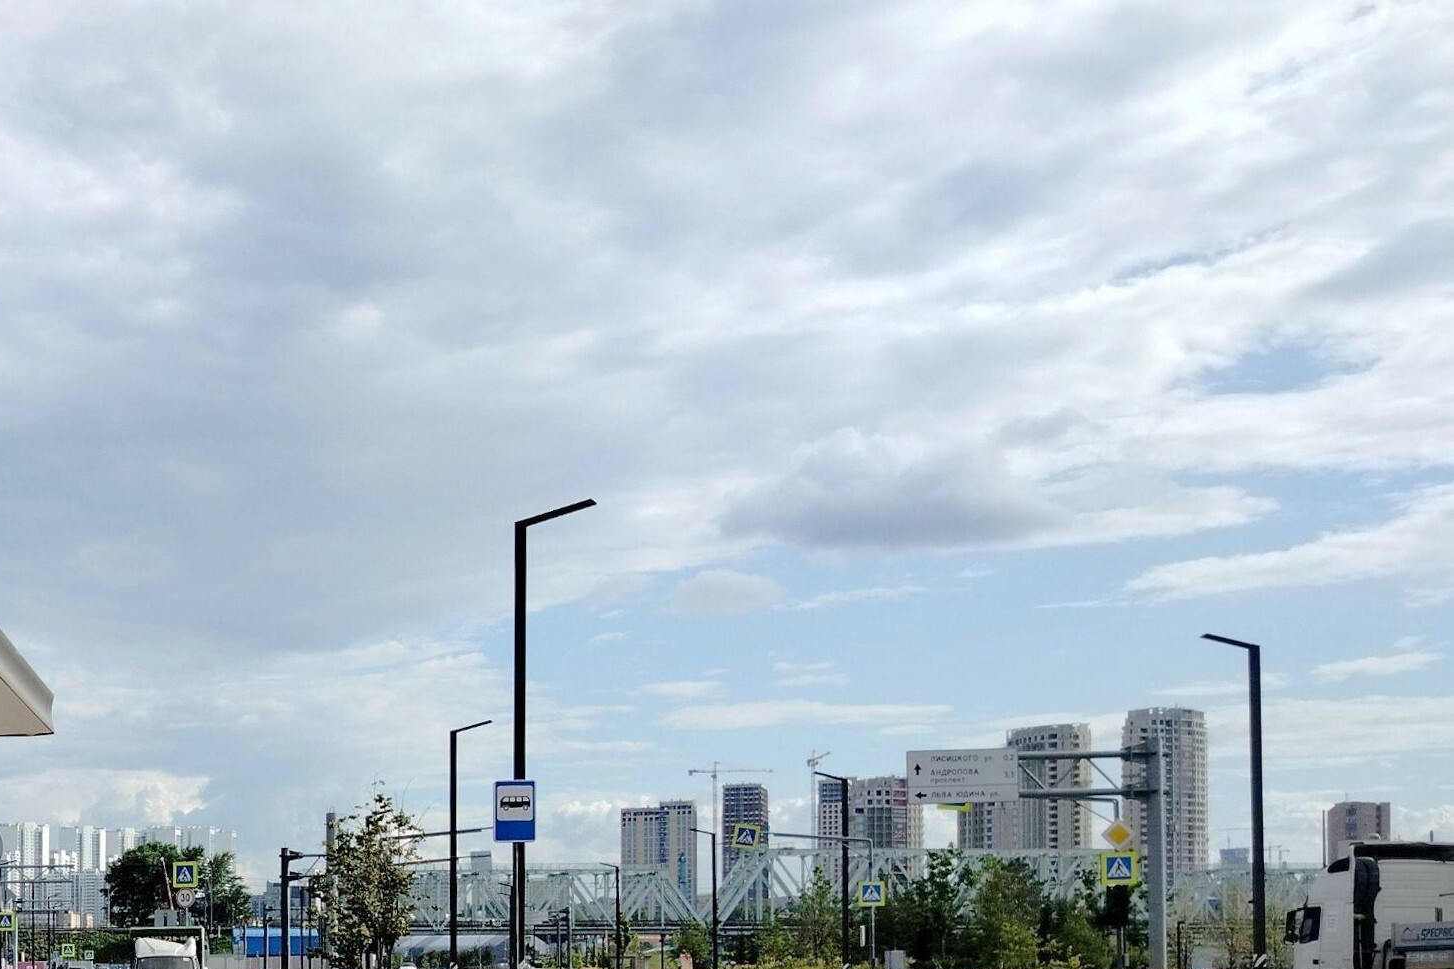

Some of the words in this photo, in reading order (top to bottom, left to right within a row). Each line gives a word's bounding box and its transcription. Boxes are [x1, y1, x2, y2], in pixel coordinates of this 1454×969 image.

[930, 768, 979, 776] АНДРОПОВА
[931, 791, 952, 799] ЛЬВА
[955, 790, 986, 798] ЮДИНА
[180, 893, 191, 902] 30
